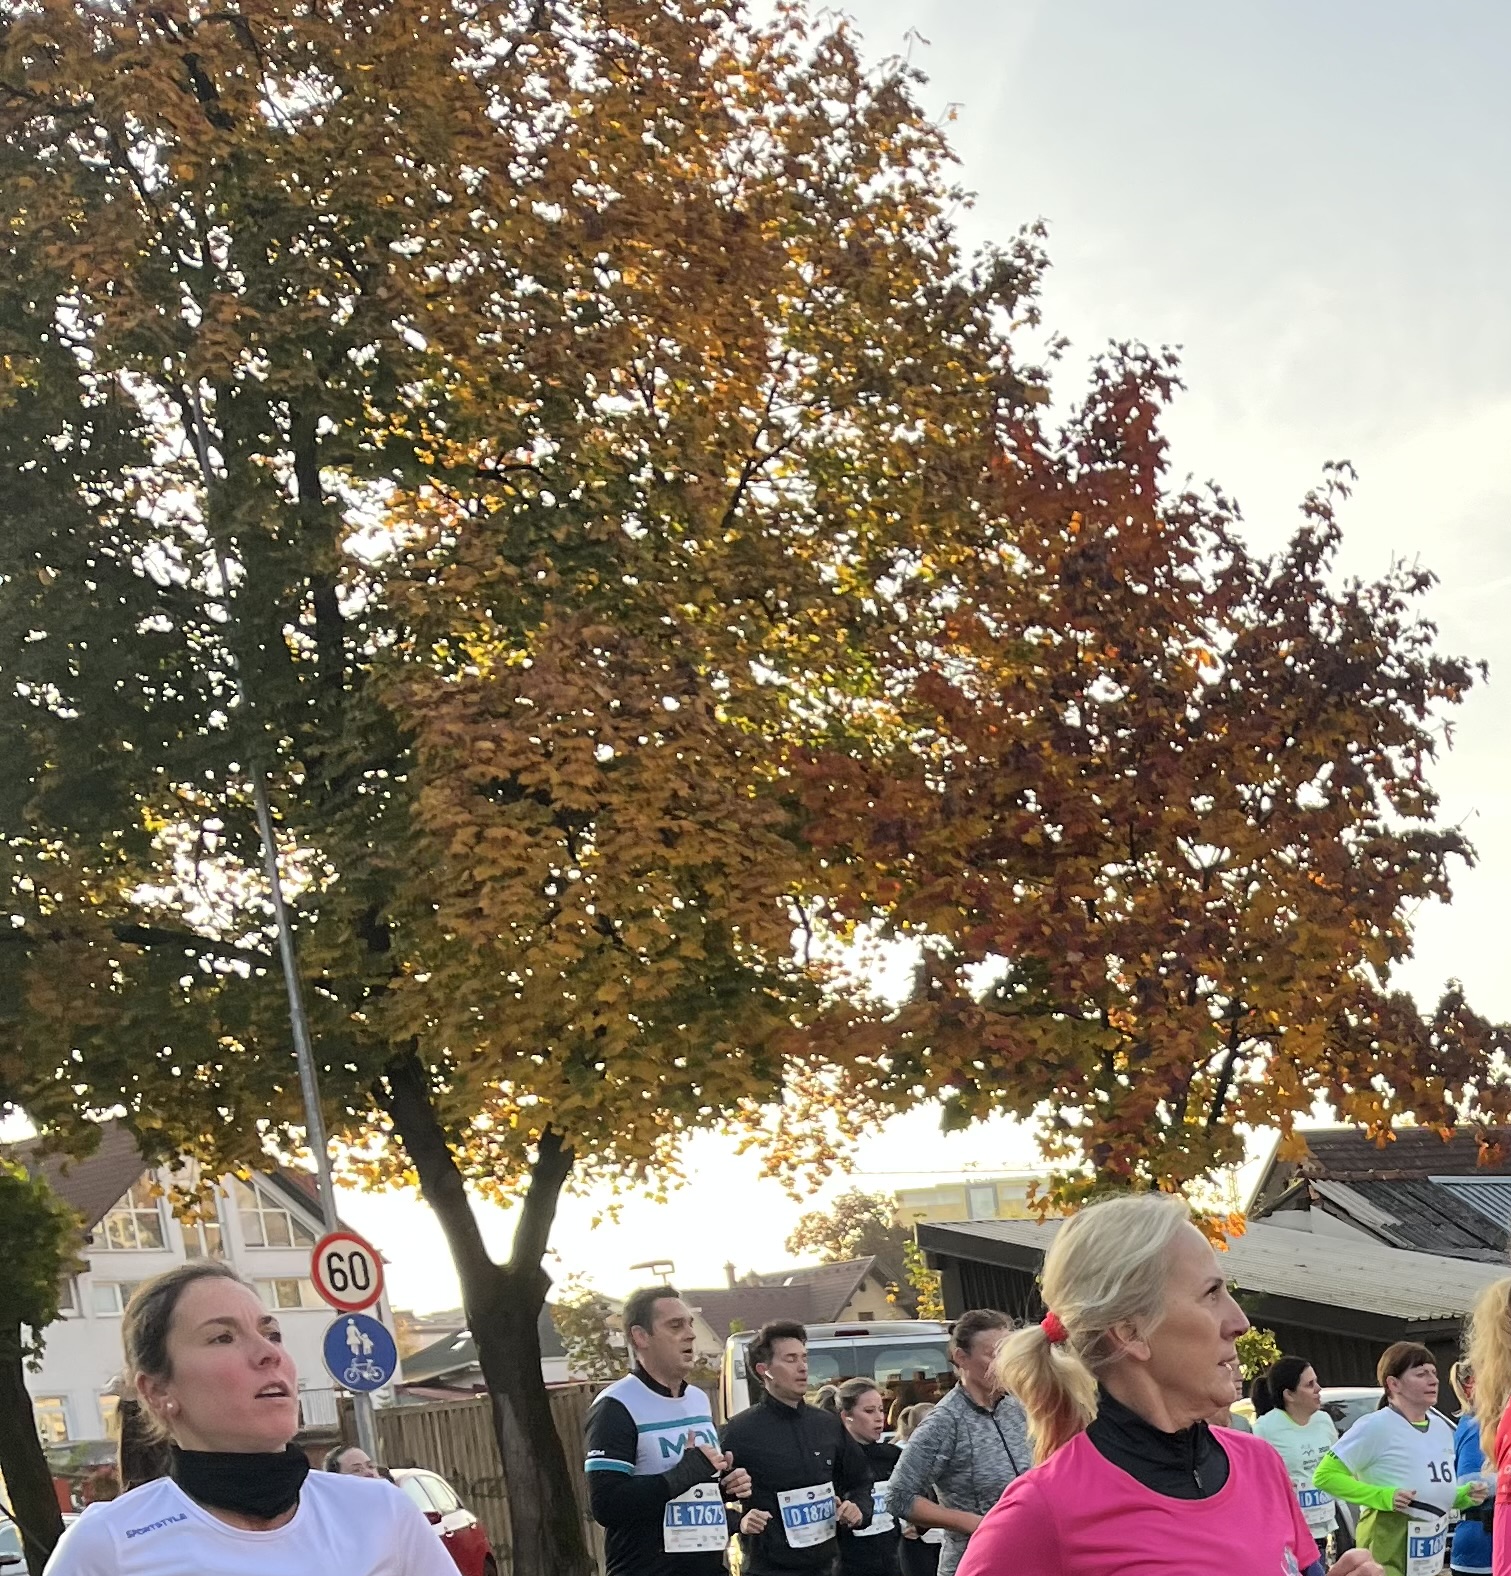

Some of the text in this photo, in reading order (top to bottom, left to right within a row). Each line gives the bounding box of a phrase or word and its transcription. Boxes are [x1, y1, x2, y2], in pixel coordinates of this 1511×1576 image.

[327, 1251, 370, 1291] 60
[1427, 1461, 1452, 1483] 16
[673, 1505, 683, 1525] E
[791, 1508, 801, 1525] D
